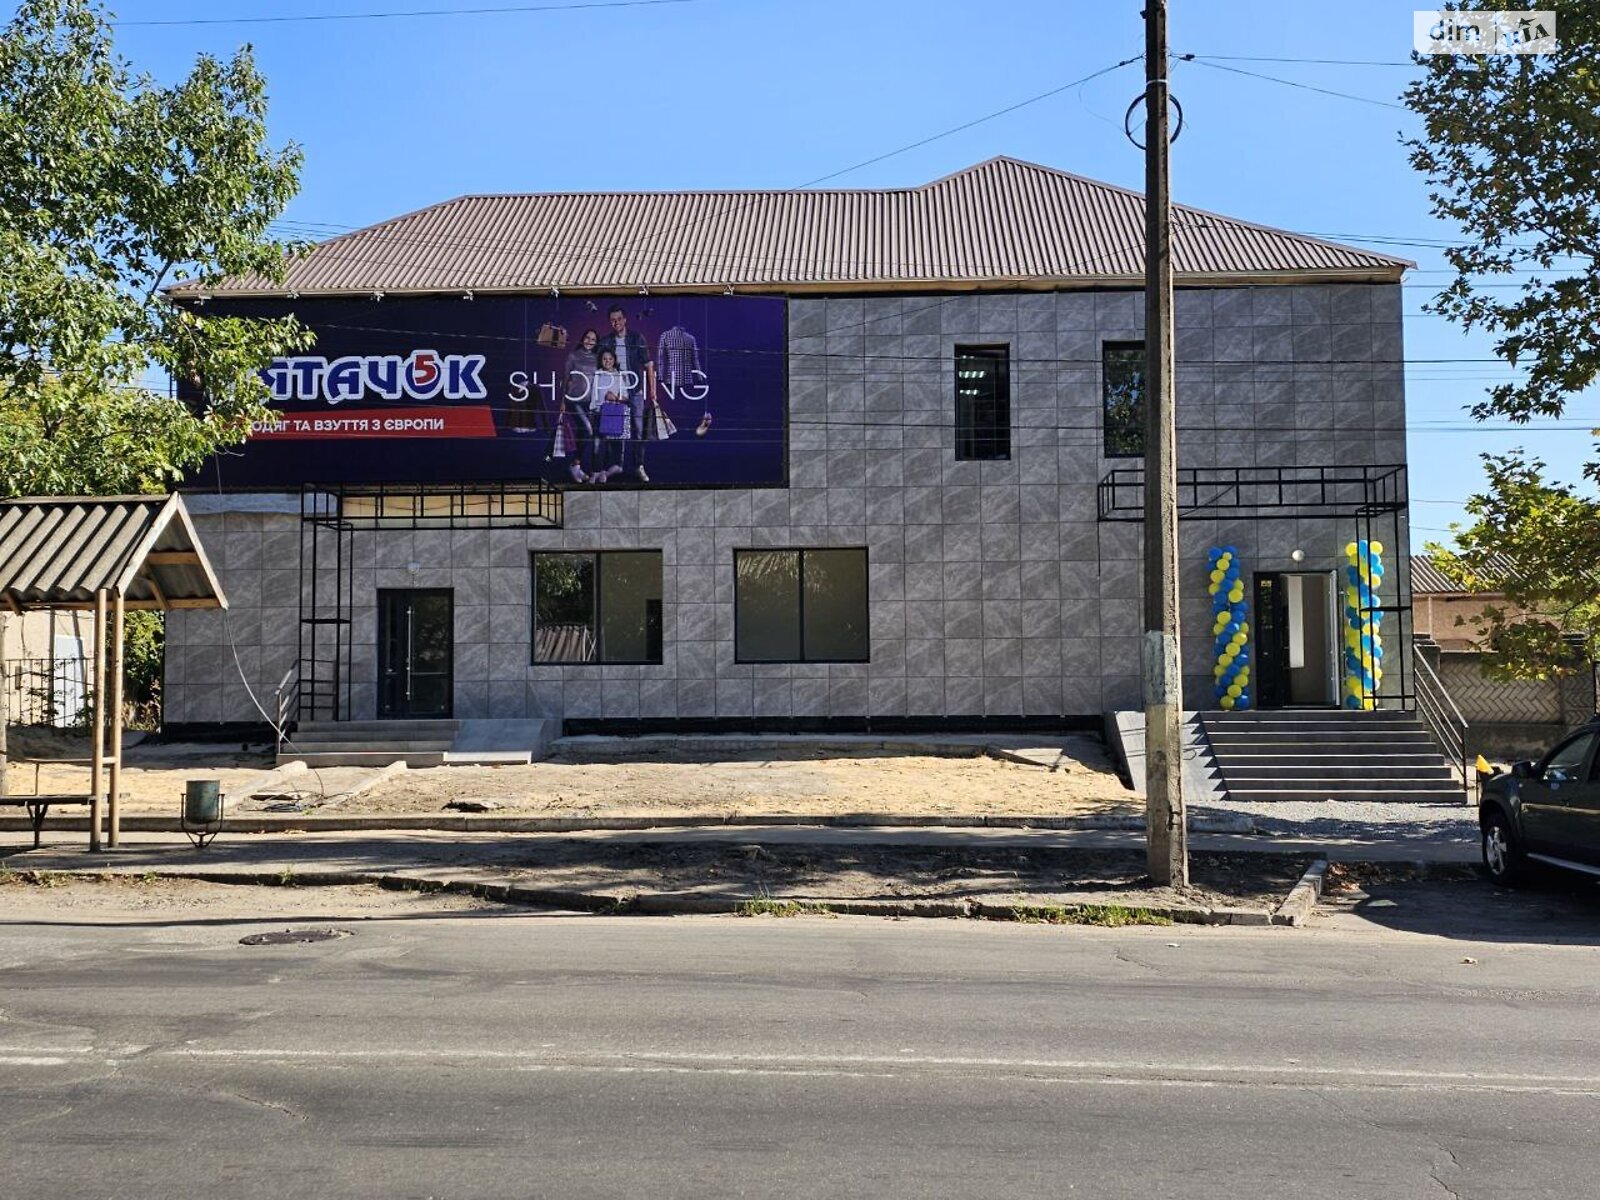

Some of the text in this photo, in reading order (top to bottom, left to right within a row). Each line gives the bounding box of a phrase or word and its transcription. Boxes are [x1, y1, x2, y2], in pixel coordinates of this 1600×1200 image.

[508, 370, 710, 402] SHOPPING
[251, 420, 290, 433] ОДЯГ
[294, 420, 311, 432] ТА
[314, 419, 369, 431] ВЗУТТЯ
[384, 418, 445, 431] ЄВРОПИ
